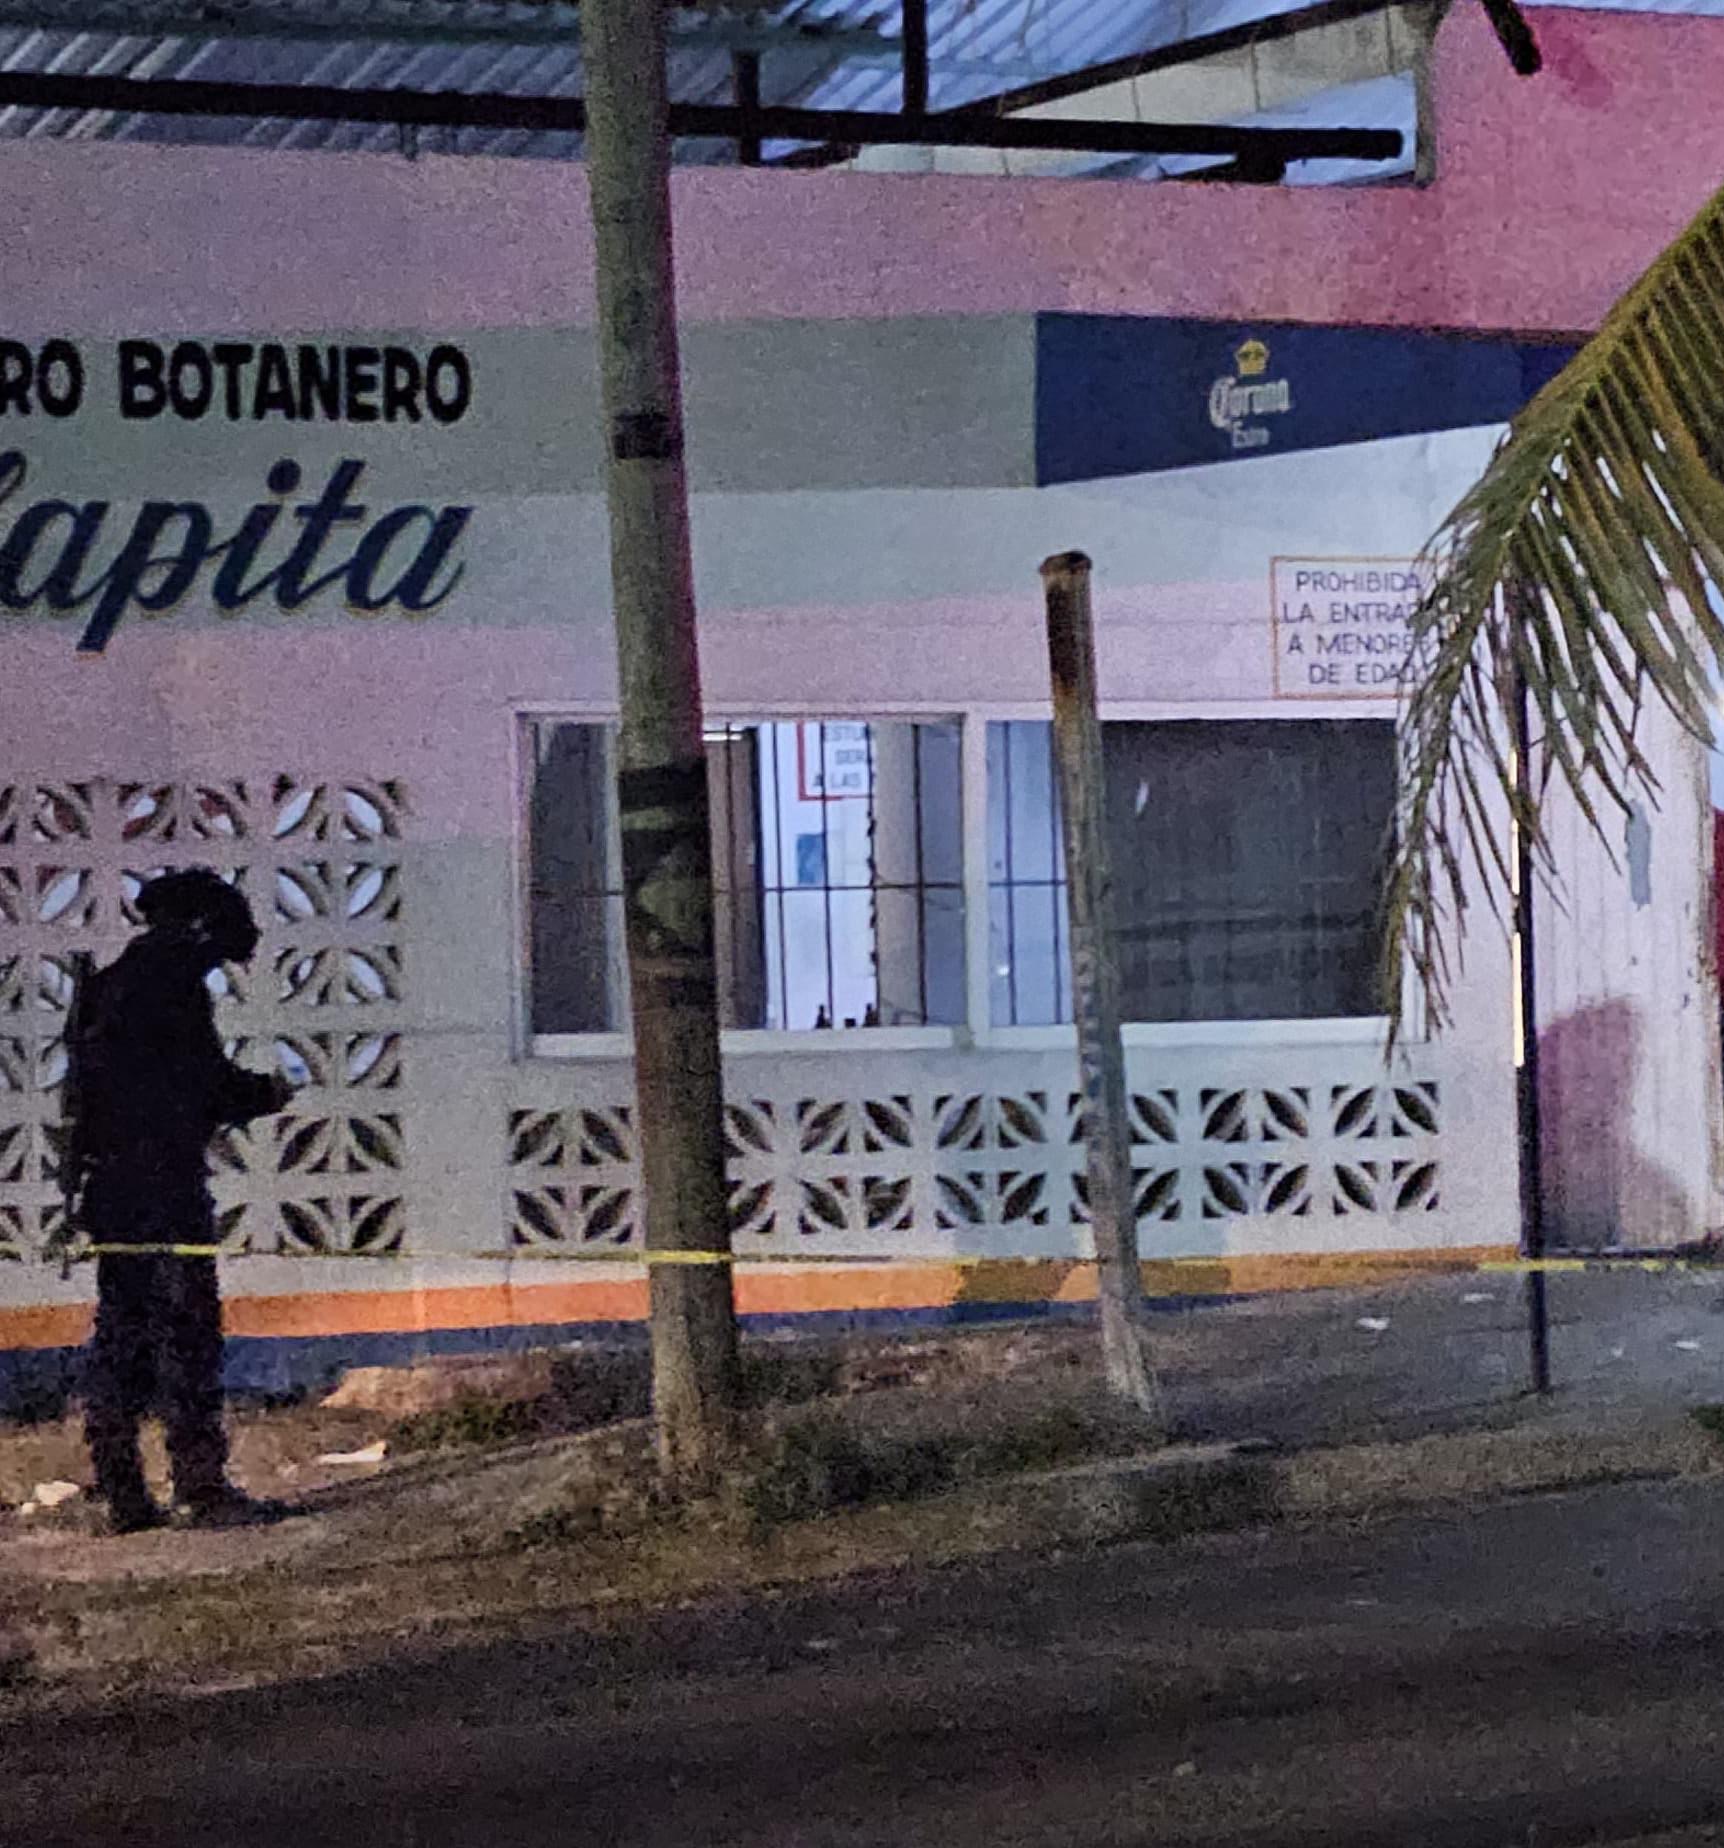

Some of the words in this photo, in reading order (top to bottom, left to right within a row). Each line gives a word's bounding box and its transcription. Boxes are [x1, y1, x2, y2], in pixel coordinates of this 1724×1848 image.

[118, 339, 472, 424] BOTANERO
[1296, 570, 1422, 593] PROHIBIDA
[1282, 602, 1313, 624] LA
[1287, 633, 1304, 655] A
[1309, 664, 1341, 685] DE
